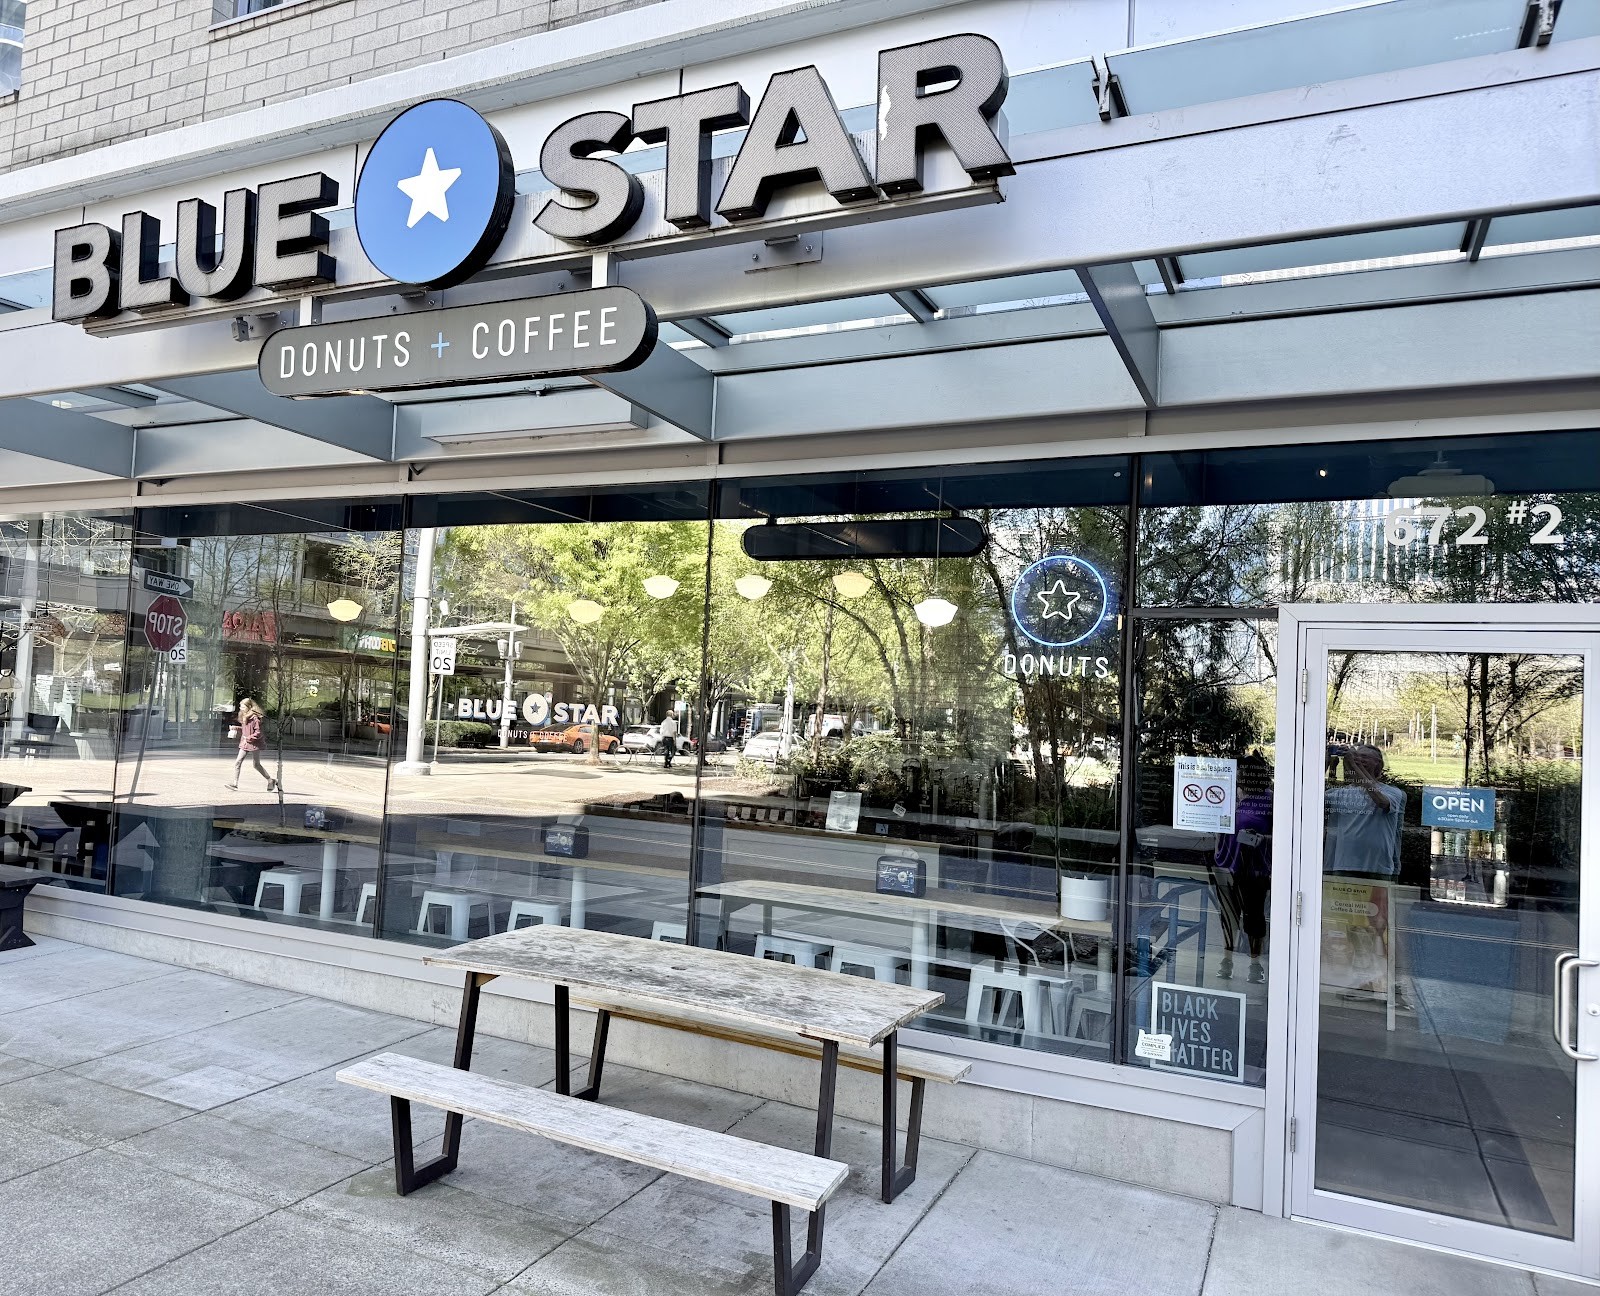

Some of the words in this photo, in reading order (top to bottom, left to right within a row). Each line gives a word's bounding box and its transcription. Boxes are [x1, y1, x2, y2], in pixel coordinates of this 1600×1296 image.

[52, 171, 339, 322] BLUE
[533, 33, 1015, 245] STAR
[279, 331, 411, 379] DONUTS
[470, 305, 619, 360] COFFEE
[1384, 504, 1489, 545] 672
[1003, 653, 1110, 679] DONUTS
[457, 697, 519, 721] BLUE
[552, 702, 620, 727] STAR
[1178, 762, 1190, 770] This
[1432, 795, 1485, 814] OPEN
[1334, 900, 1354, 908] Cereal
[1161, 991, 1219, 1021] BLACK
[1141, 1041, 1166, 1050] COMPLIED
